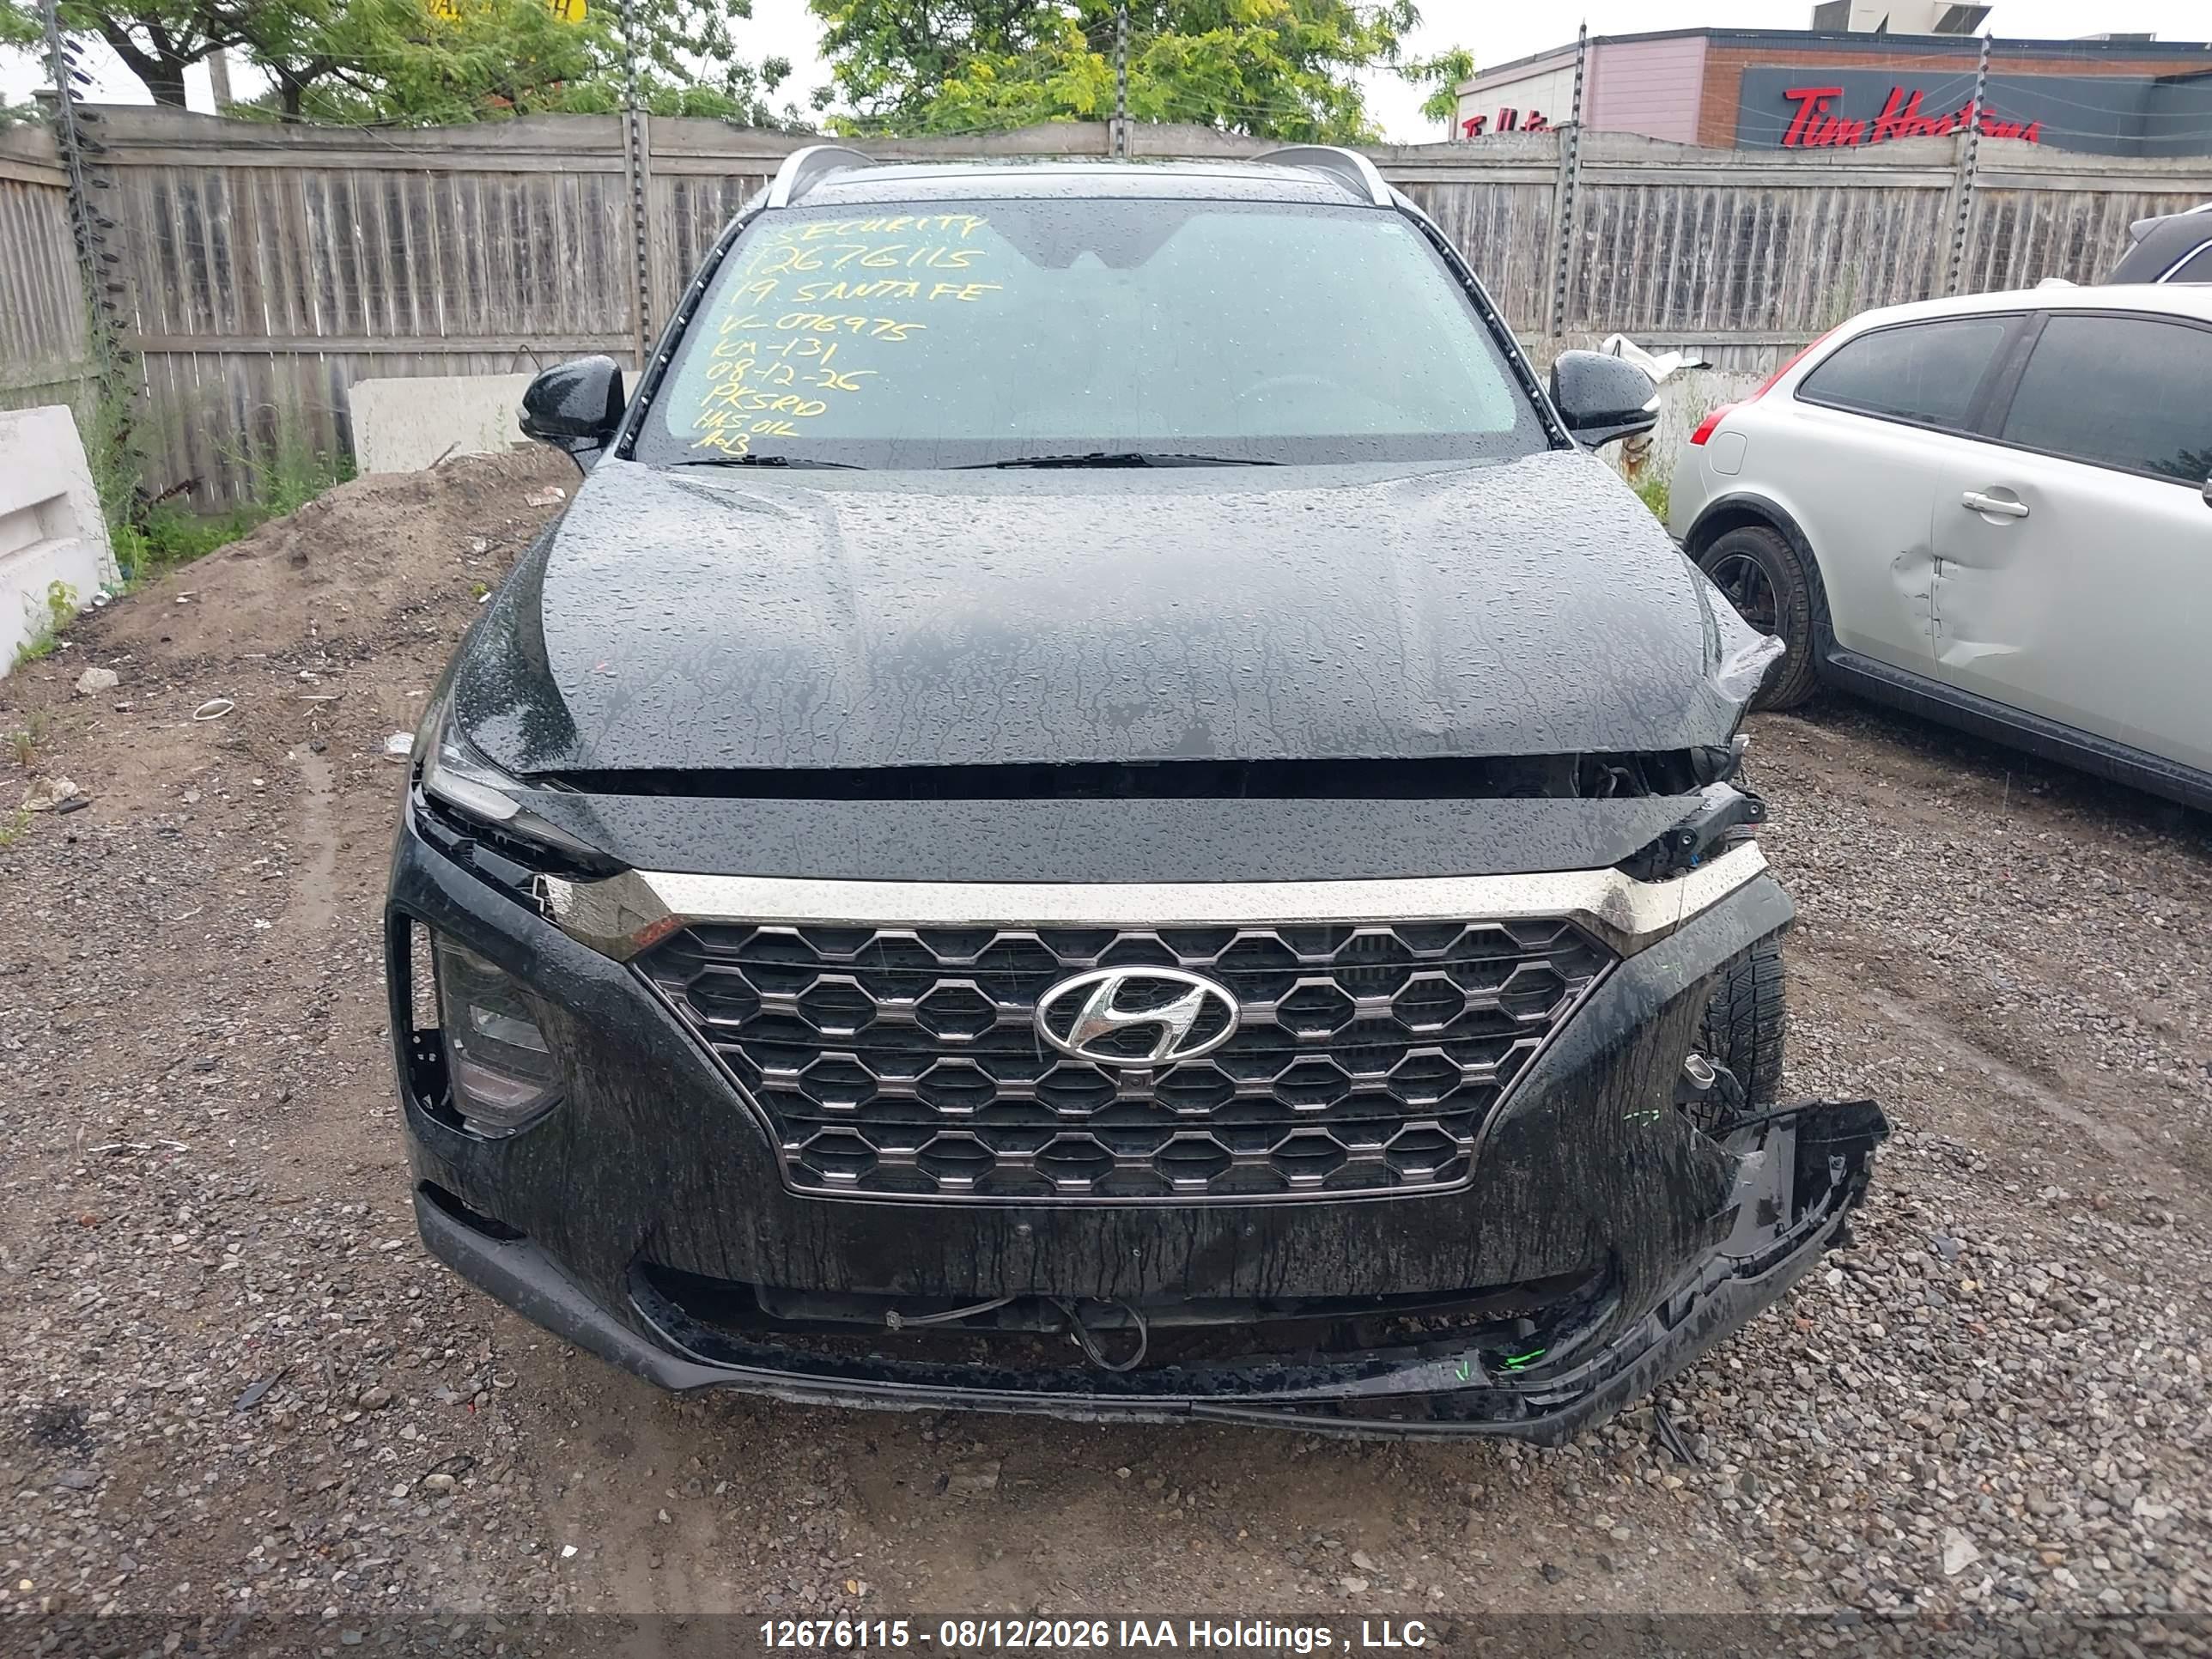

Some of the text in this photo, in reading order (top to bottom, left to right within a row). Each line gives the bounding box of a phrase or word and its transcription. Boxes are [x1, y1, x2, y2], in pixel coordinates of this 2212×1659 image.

[1784, 87, 1867, 148] Tim
[764, 215, 989, 246] SECURITY
[745, 245, 988, 276] 12676115
[731, 279, 1004, 307] 19 SANTA FE
